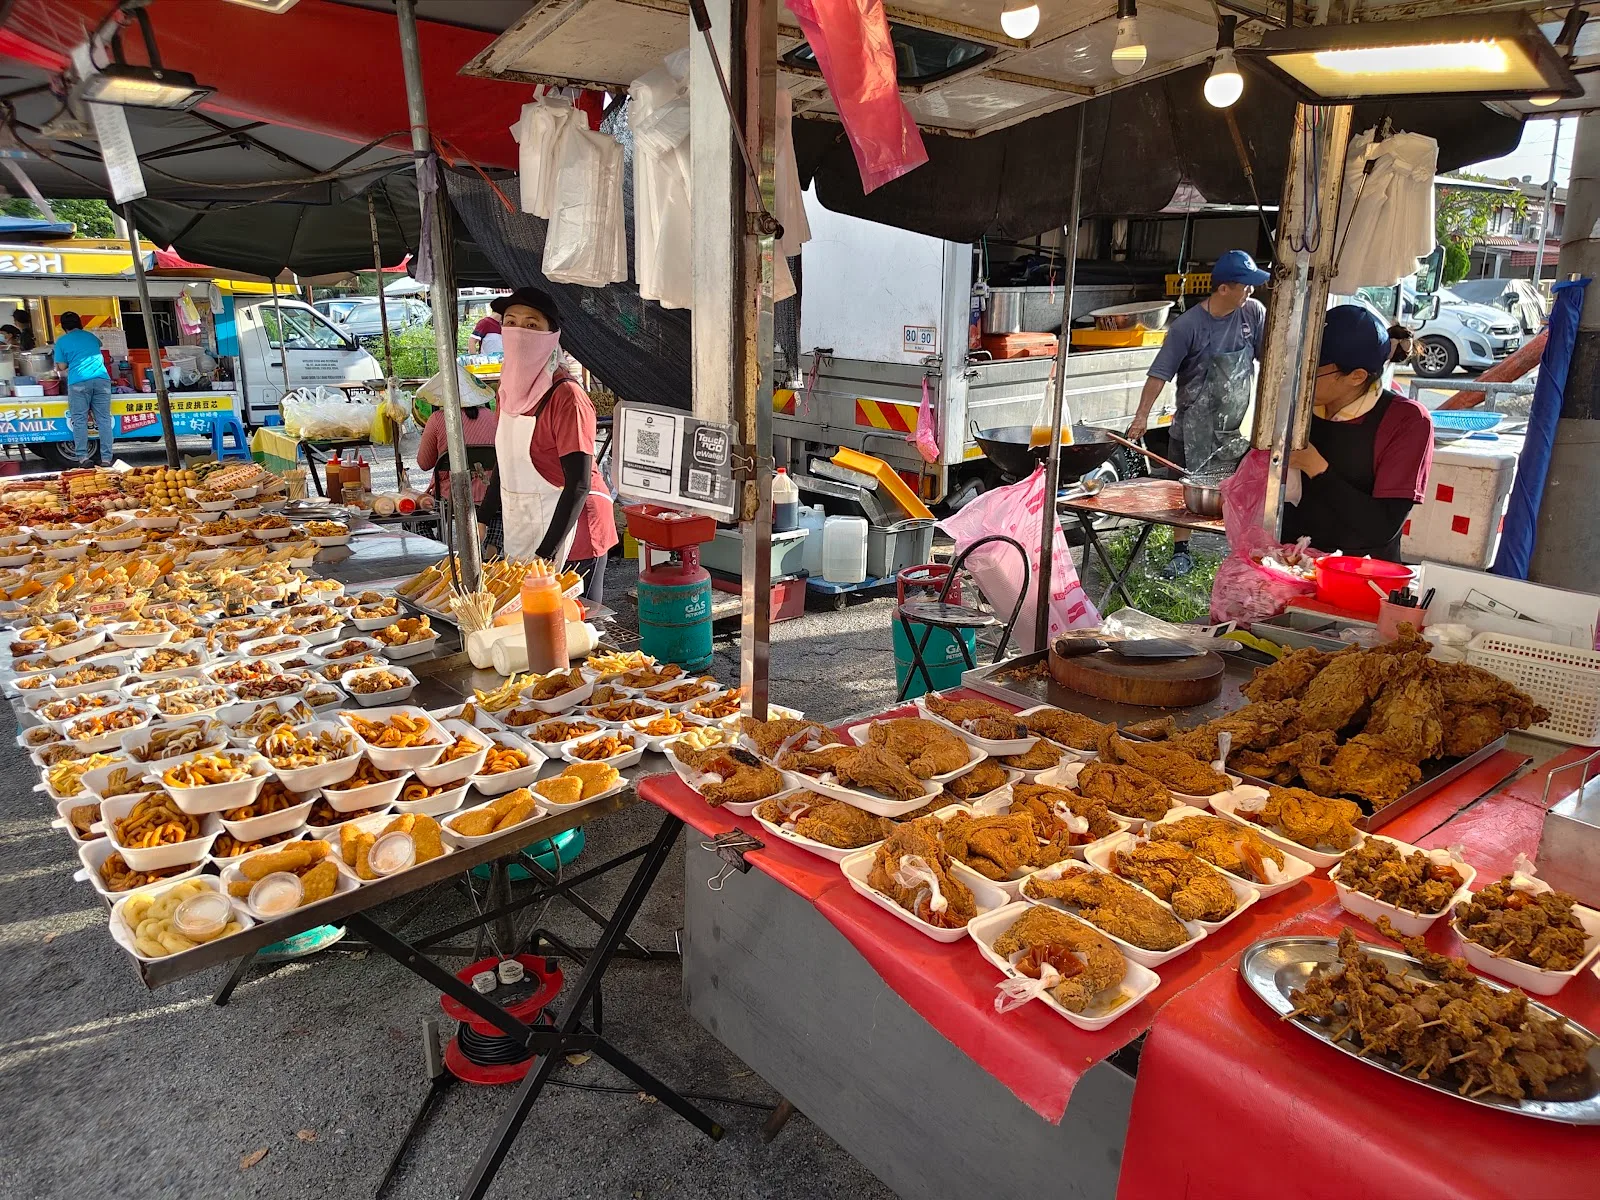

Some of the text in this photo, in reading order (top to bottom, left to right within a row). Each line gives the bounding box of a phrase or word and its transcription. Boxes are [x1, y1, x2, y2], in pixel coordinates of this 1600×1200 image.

[906, 330, 931, 344] 80 90
[20, 421, 57, 432] MILK
[698, 433, 724, 445] Touch
[696, 451, 724, 461] eWallet
[685, 601, 705, 613] GAS
